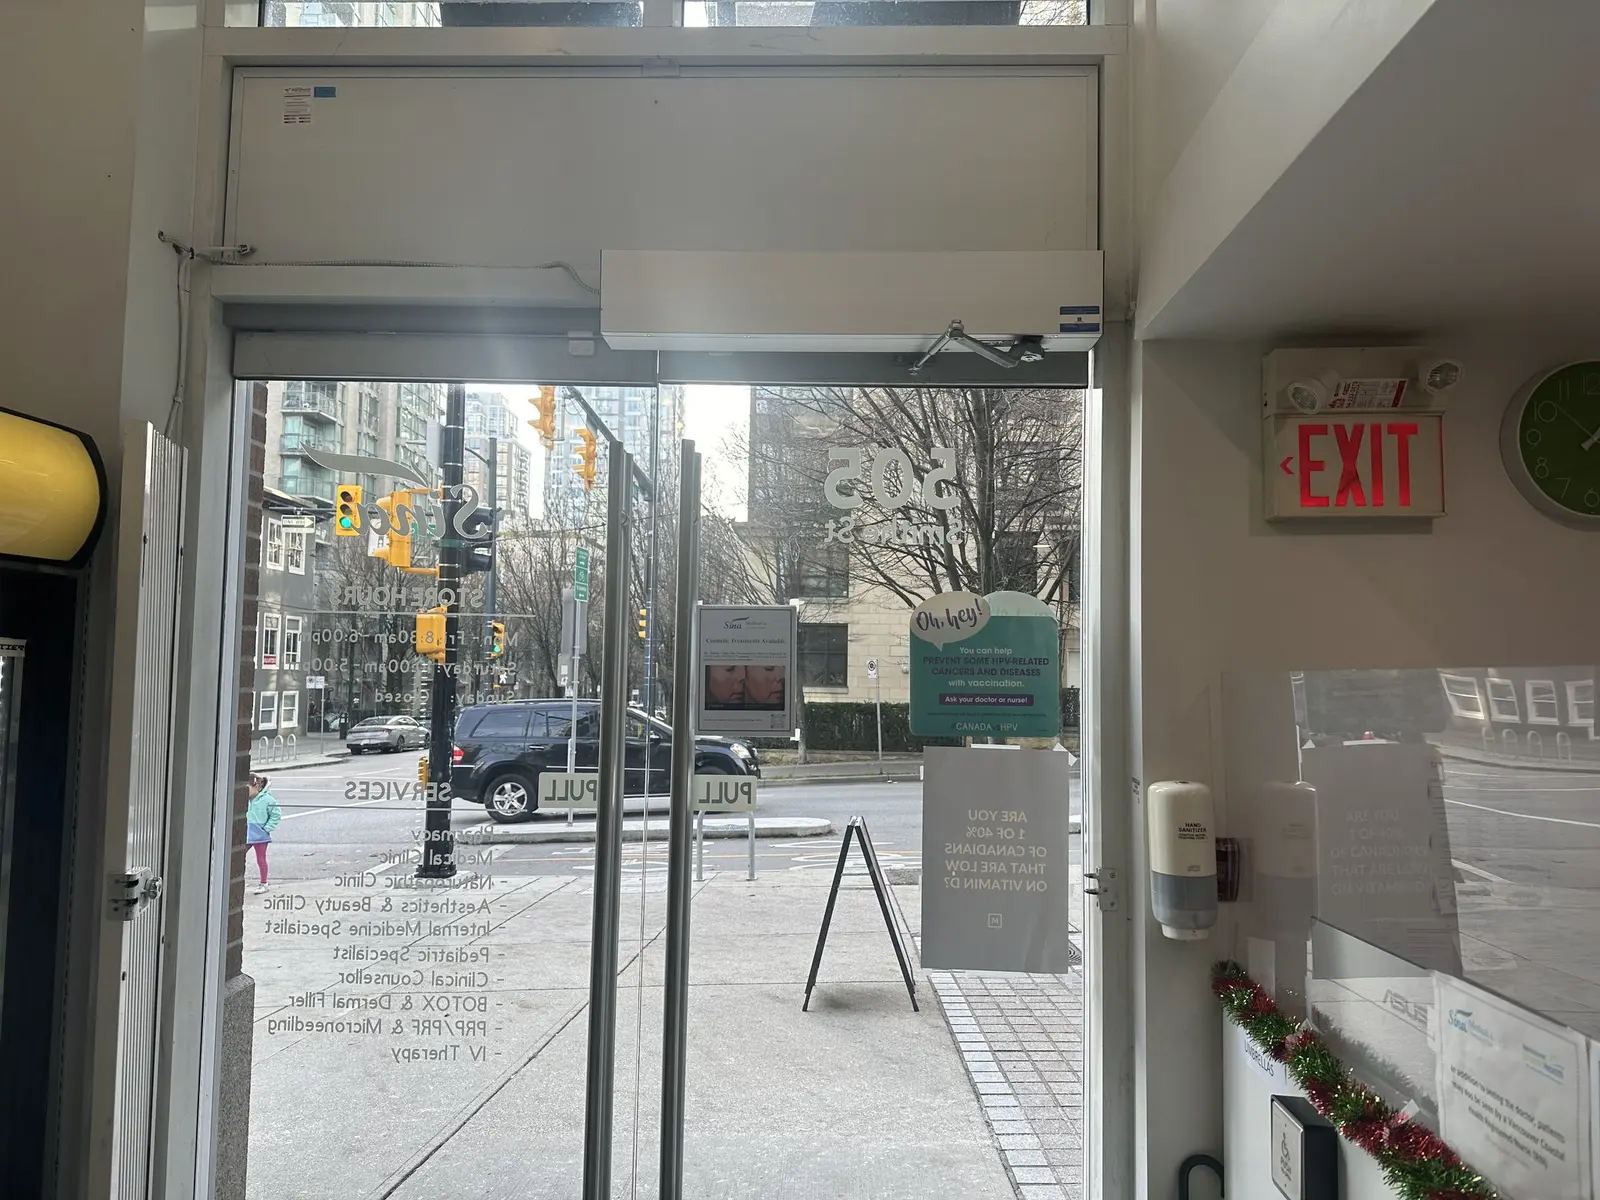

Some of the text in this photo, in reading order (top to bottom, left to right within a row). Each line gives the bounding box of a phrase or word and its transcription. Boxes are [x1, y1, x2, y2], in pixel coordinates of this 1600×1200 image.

[1533, 400, 1558, 423] 10
[1525, 428, 1541, 450] 9
[1298, 422, 1418, 508] EXIT
[1535, 457, 1549, 479] 8
[1554, 477, 1571, 499] 7
[1584, 487, 1600, 508] 6
[916, 598, 983, 631] Oh, hey!
[723, 620, 743, 630] Sina
[959, 646, 975, 655] You
[994, 646, 1013, 656] help
[922, 656, 1050, 666] PREVENT SOME HPV-RELATED
[931, 667, 1042, 677] CANCERS AND DISEASES
[948, 679, 1026, 688] with vaccination.
[944, 695, 958, 703] Ask
[974, 695, 998, 703] doctor
[1007, 696, 1028, 704] nurse!
[956, 723, 993, 731] CANADA
[1000, 723, 1018, 731] HPV
